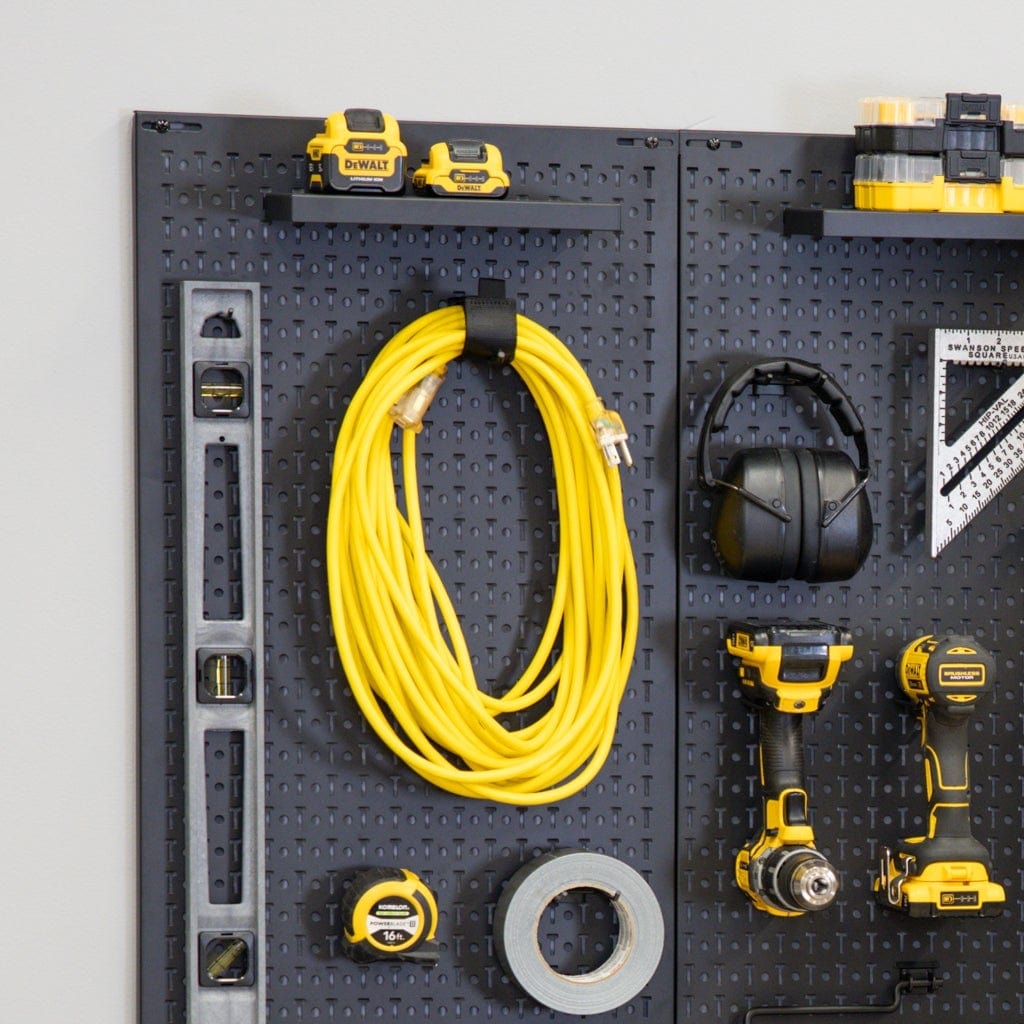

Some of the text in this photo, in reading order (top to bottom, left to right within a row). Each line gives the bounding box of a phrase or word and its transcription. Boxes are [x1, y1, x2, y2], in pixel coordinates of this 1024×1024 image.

[948, 344, 996, 352] SWANSON
[978, 398, 1008, 426] HIP-VAL
[986, 422, 994, 430] 10
[993, 415, 1001, 423] 12
[1001, 407, 1009, 415] 15
[1008, 400, 1016, 408] 18
[1017, 432, 1024, 440] 10
[960, 503, 968, 512] 10
[973, 491, 981, 500] 15
[983, 479, 992, 488] 20
[994, 469, 1003, 478] 25
[1004, 459, 1013, 468] 30
[1013, 448, 1023, 458] 35
[383, 931, 396, 940] 16
